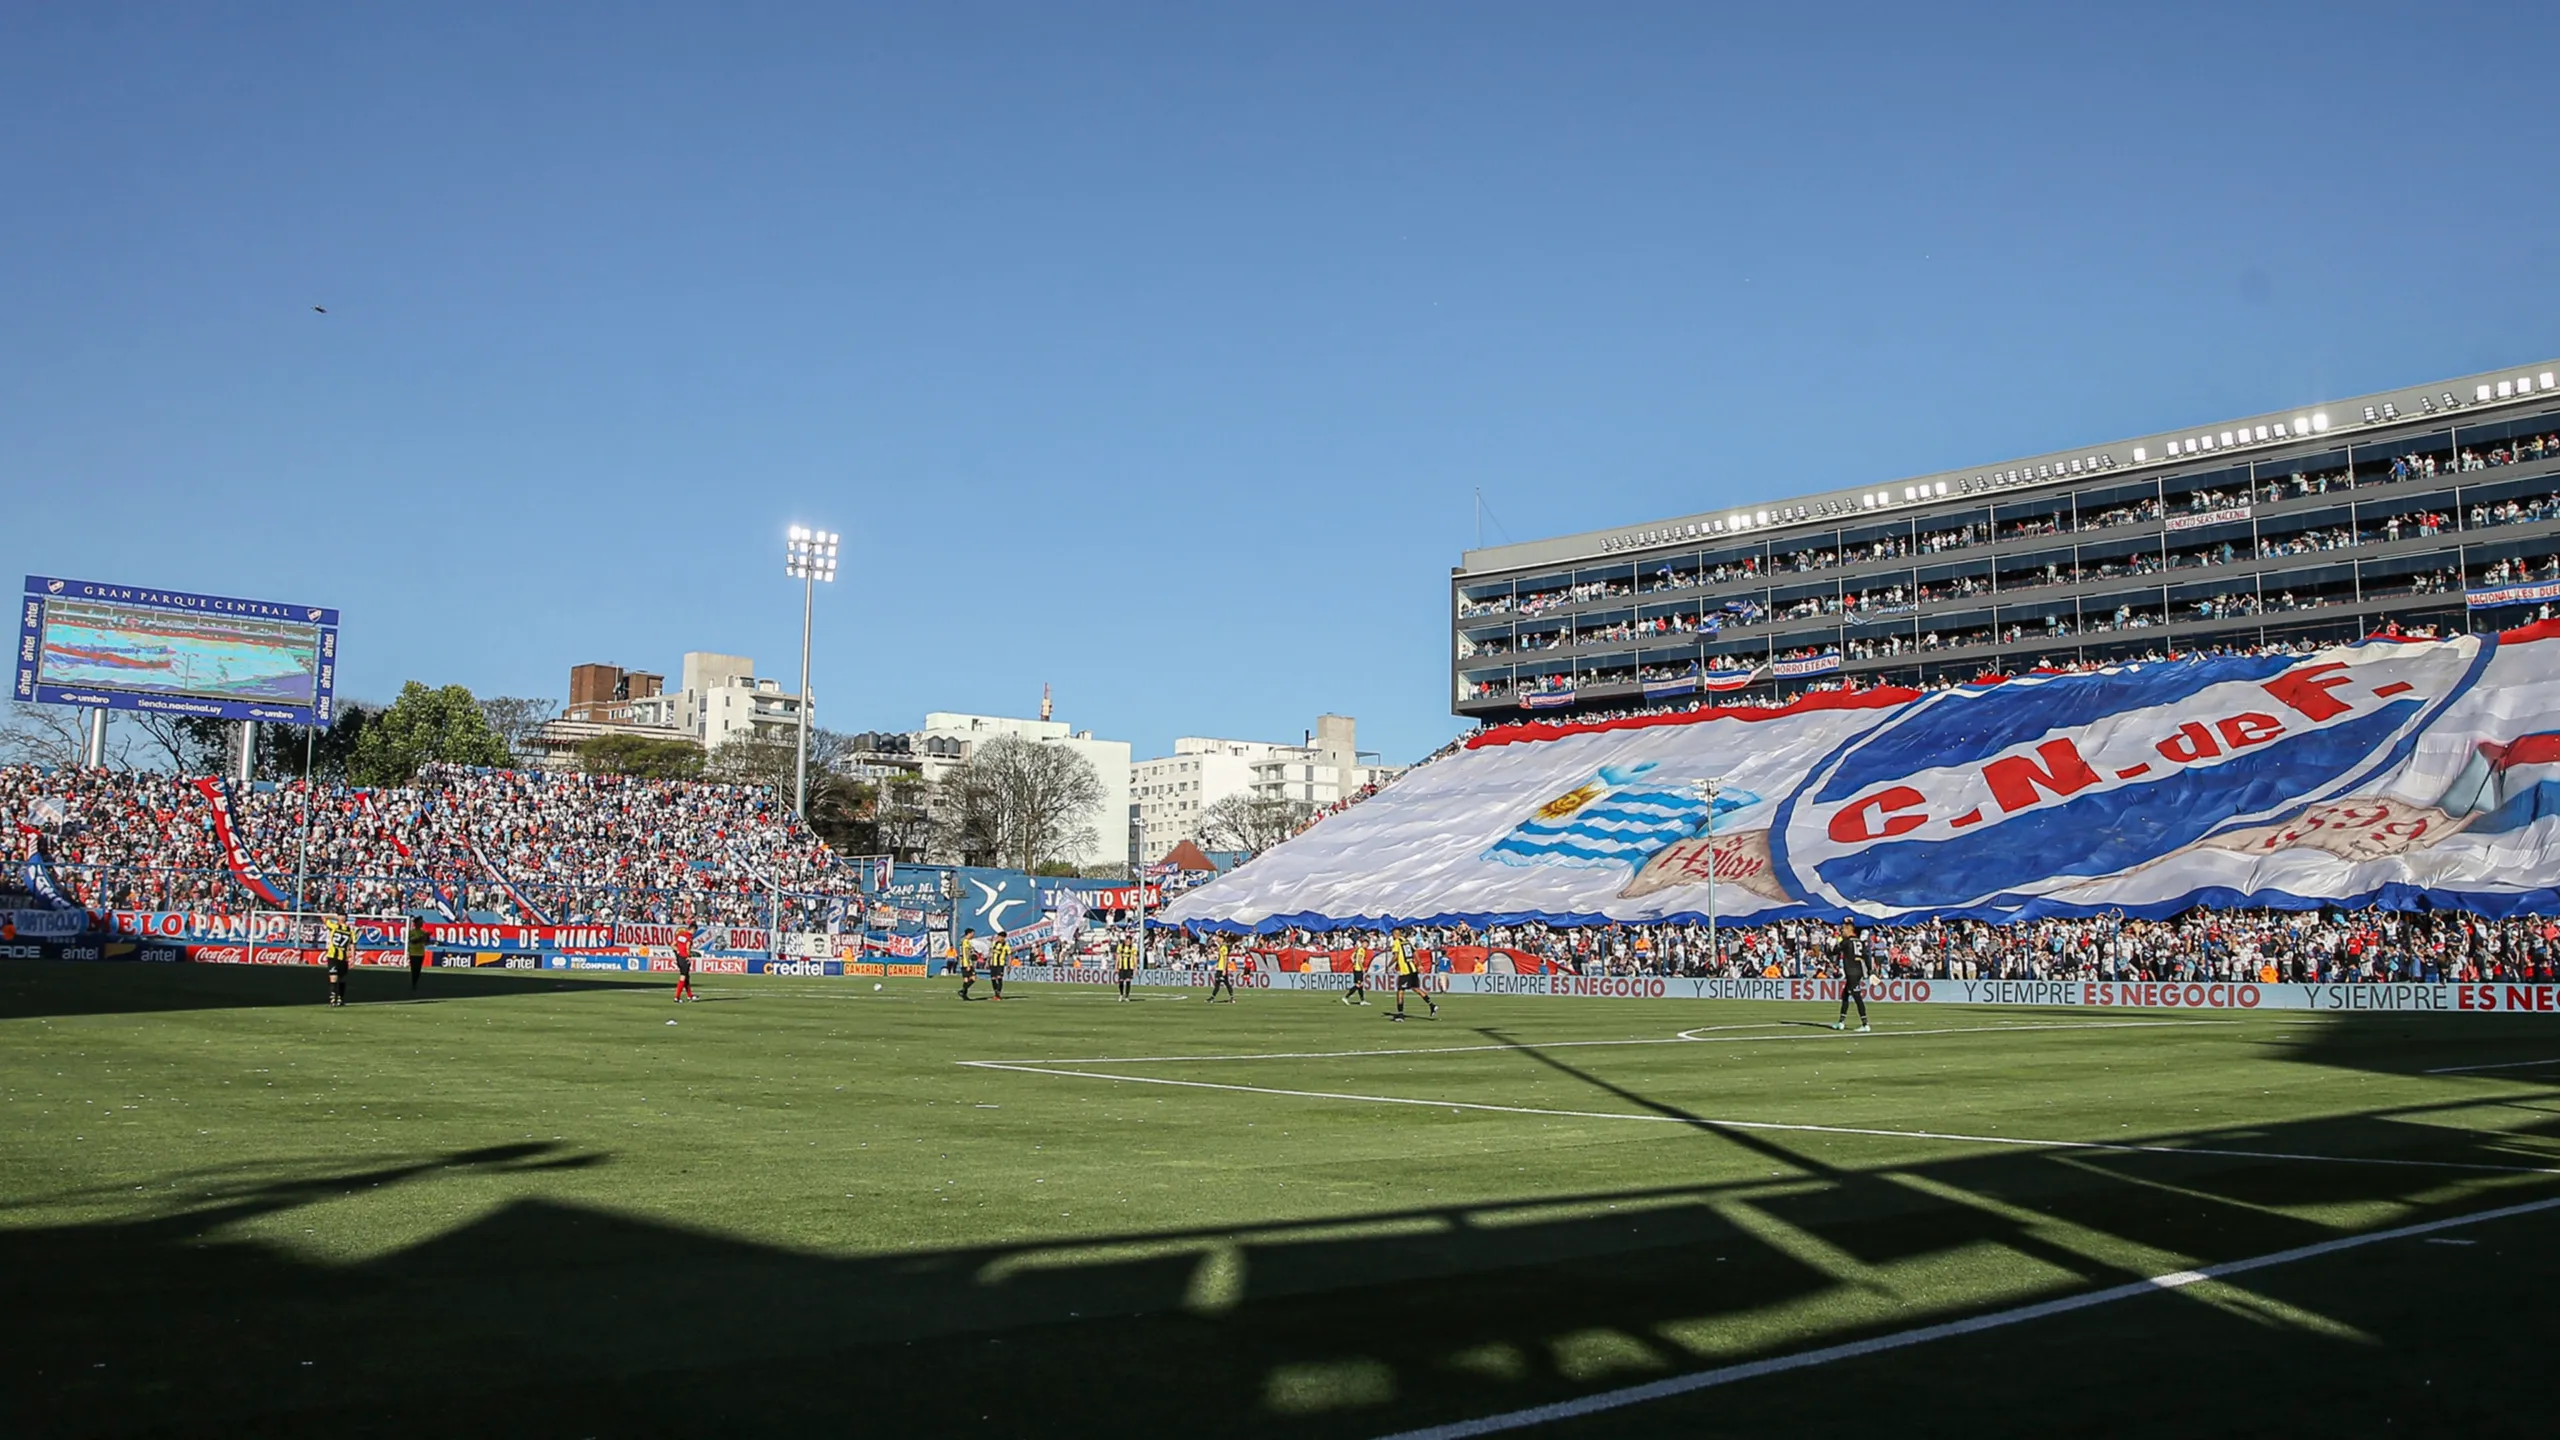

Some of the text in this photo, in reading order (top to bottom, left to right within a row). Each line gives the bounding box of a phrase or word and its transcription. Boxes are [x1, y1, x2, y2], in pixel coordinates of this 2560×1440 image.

[2196, 514, 2214, 525] SEAS
[84, 586, 290, 617] GRAN PARQUE CENTRAL
[2466, 584, 2560, 605] NACIONAL LES DUE
[25, 602, 39, 628] antel
[22, 636, 36, 662] antel
[322, 633, 335, 658] antel
[1804, 657, 1839, 672] ETERNO
[18, 669, 33, 695] antel
[320, 664, 332, 689] antel
[77, 695, 110, 704] umbro
[138, 699, 223, 715] tienda.nacional.uy
[264, 710, 294, 719] umbro
[317, 696, 330, 720] antel
[1119, 888, 1158, 906] VERA
[87, 909, 184, 935] MELO
[193, 913, 287, 941] PANDO
[333, 933, 349, 947] 27
[435, 927, 501, 948] BOLSOS
[518, 929, 540, 949] DE
[554, 929, 608, 948] MINAS
[616, 924, 674, 946] ROSARIO
[62, 946, 99, 960] antel
[141, 947, 176, 962] antel
[1852, 940, 1863, 956] 12
[442, 953, 471, 968] antel
[505, 956, 535, 969] antel
[571, 961, 621, 970] RECOMPENSA
[703, 960, 743, 972] PILSEN
[763, 961, 824, 976] creditel
[844, 963, 884, 976] CANARIAS
[887, 964, 926, 977] CANARIAS
[1013, 968, 1051, 982] SIEMPRE
[1053, 970, 1065, 982] ES
[1145, 971, 1188, 986] SIEMPRE
[1191, 972, 1205, 987] ES
[1208, 971, 1270, 988] NGOCIO
[1288, 974, 1297, 987] Y
[1300, 974, 1351, 990] SIEMPRE
[1471, 975, 1666, 998] Y SIEMPRE ES NEGOCIO
[1693, 980, 1931, 1002] Y SIEMPRE ES NEOCIO
[1964, 981, 2261, 1008] Y SIEMPRE ES NEGOCIO
[2303, 985, 2321, 1008] Y
[2328, 985, 2448, 1010] SIEMPRE
[2457, 985, 2497, 1010] ES
